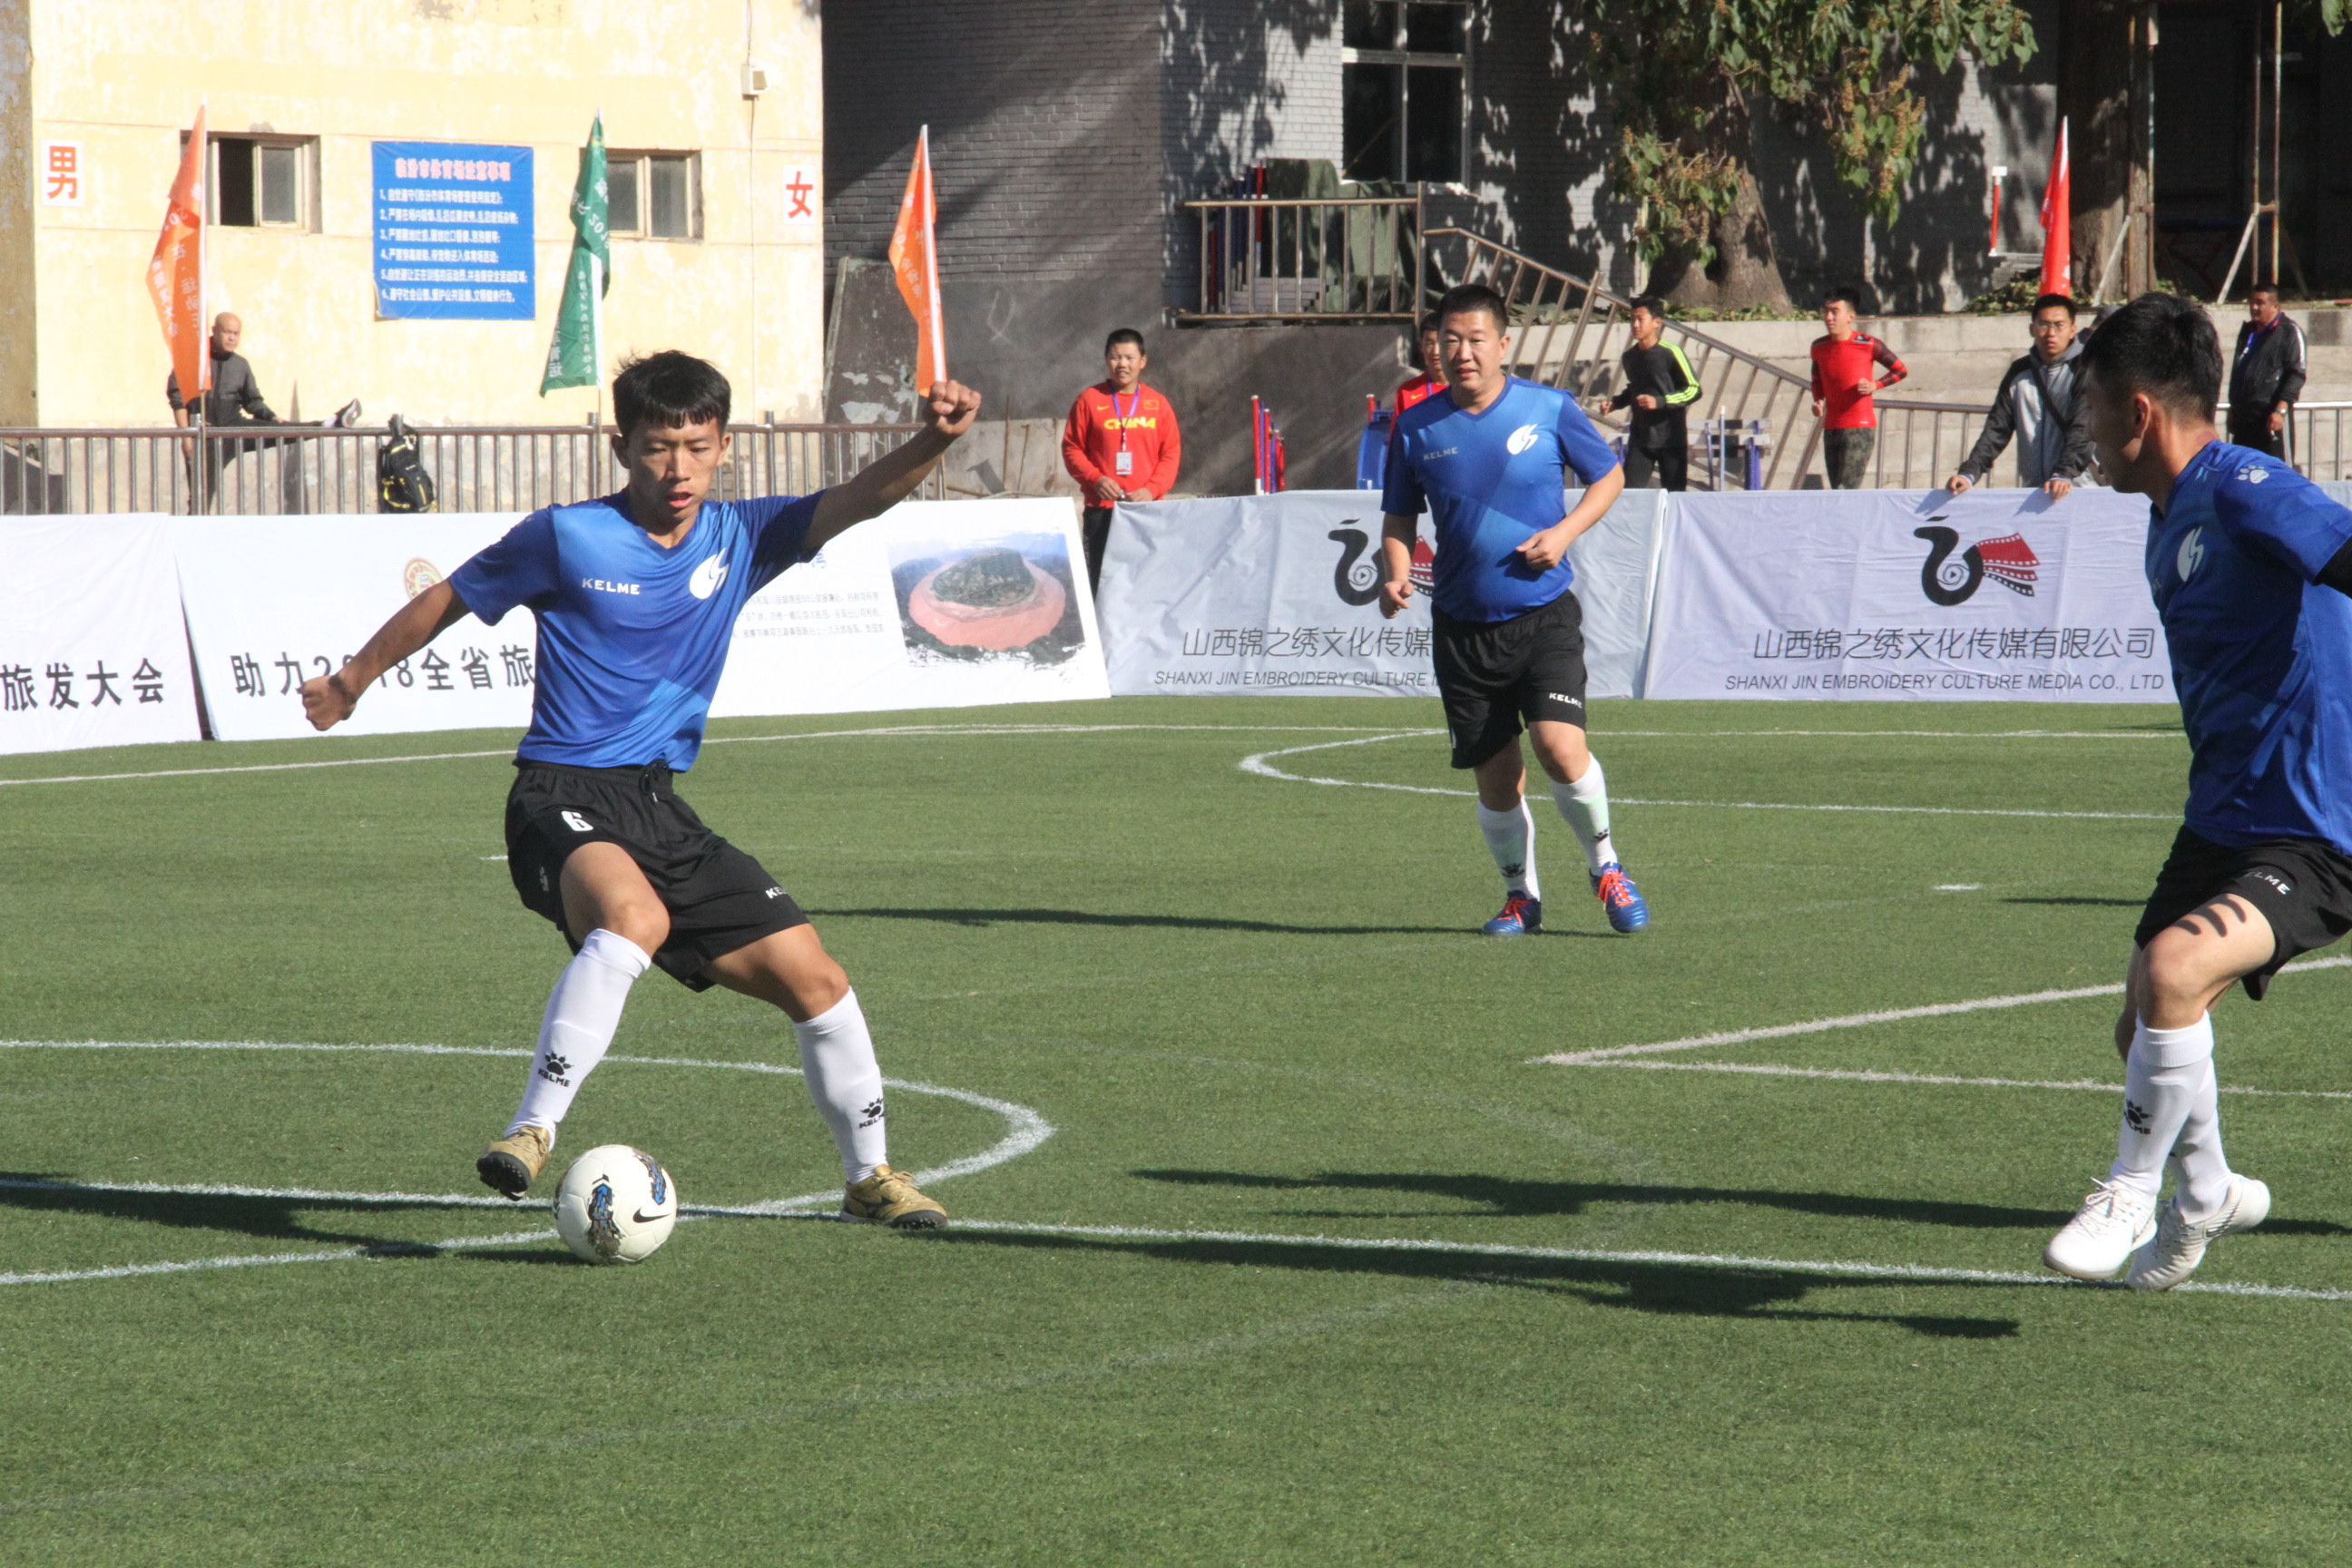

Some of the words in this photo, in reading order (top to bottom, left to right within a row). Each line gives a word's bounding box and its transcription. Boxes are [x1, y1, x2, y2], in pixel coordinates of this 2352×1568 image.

[47, 145, 78, 200] 男
[786, 171, 814, 220] 女
[1103, 416, 1156, 429] CHINA
[1423, 446, 1459, 461] KELME
[582, 577, 641, 595] KELME
[1182, 626, 1434, 658] 山西锦之绣文化传媒
[1753, 626, 2155, 660] 山西锦之绣文化传媒有限公司
[0, 657, 164, 711] 旅发大会
[1154, 670, 1213, 686] SHANXI
[1216, 671, 1240, 686] JIN
[1243, 671, 1349, 687] EMBROIDERY
[1353, 671, 1428, 687] CULTURE
[1725, 674, 1788, 691] SHANXI
[1792, 674, 1818, 690] JIN
[1822, 674, 1937, 690] EMBROIDERY
[1942, 674, 2024, 690] CULTURE
[2028, 674, 2083, 690] MEDIA
[2089, 674, 2124, 691] CO.,
[2131, 674, 2165, 690] LTD
[561, 810, 594, 831] 6
[537, 1067, 571, 1087] KELME
